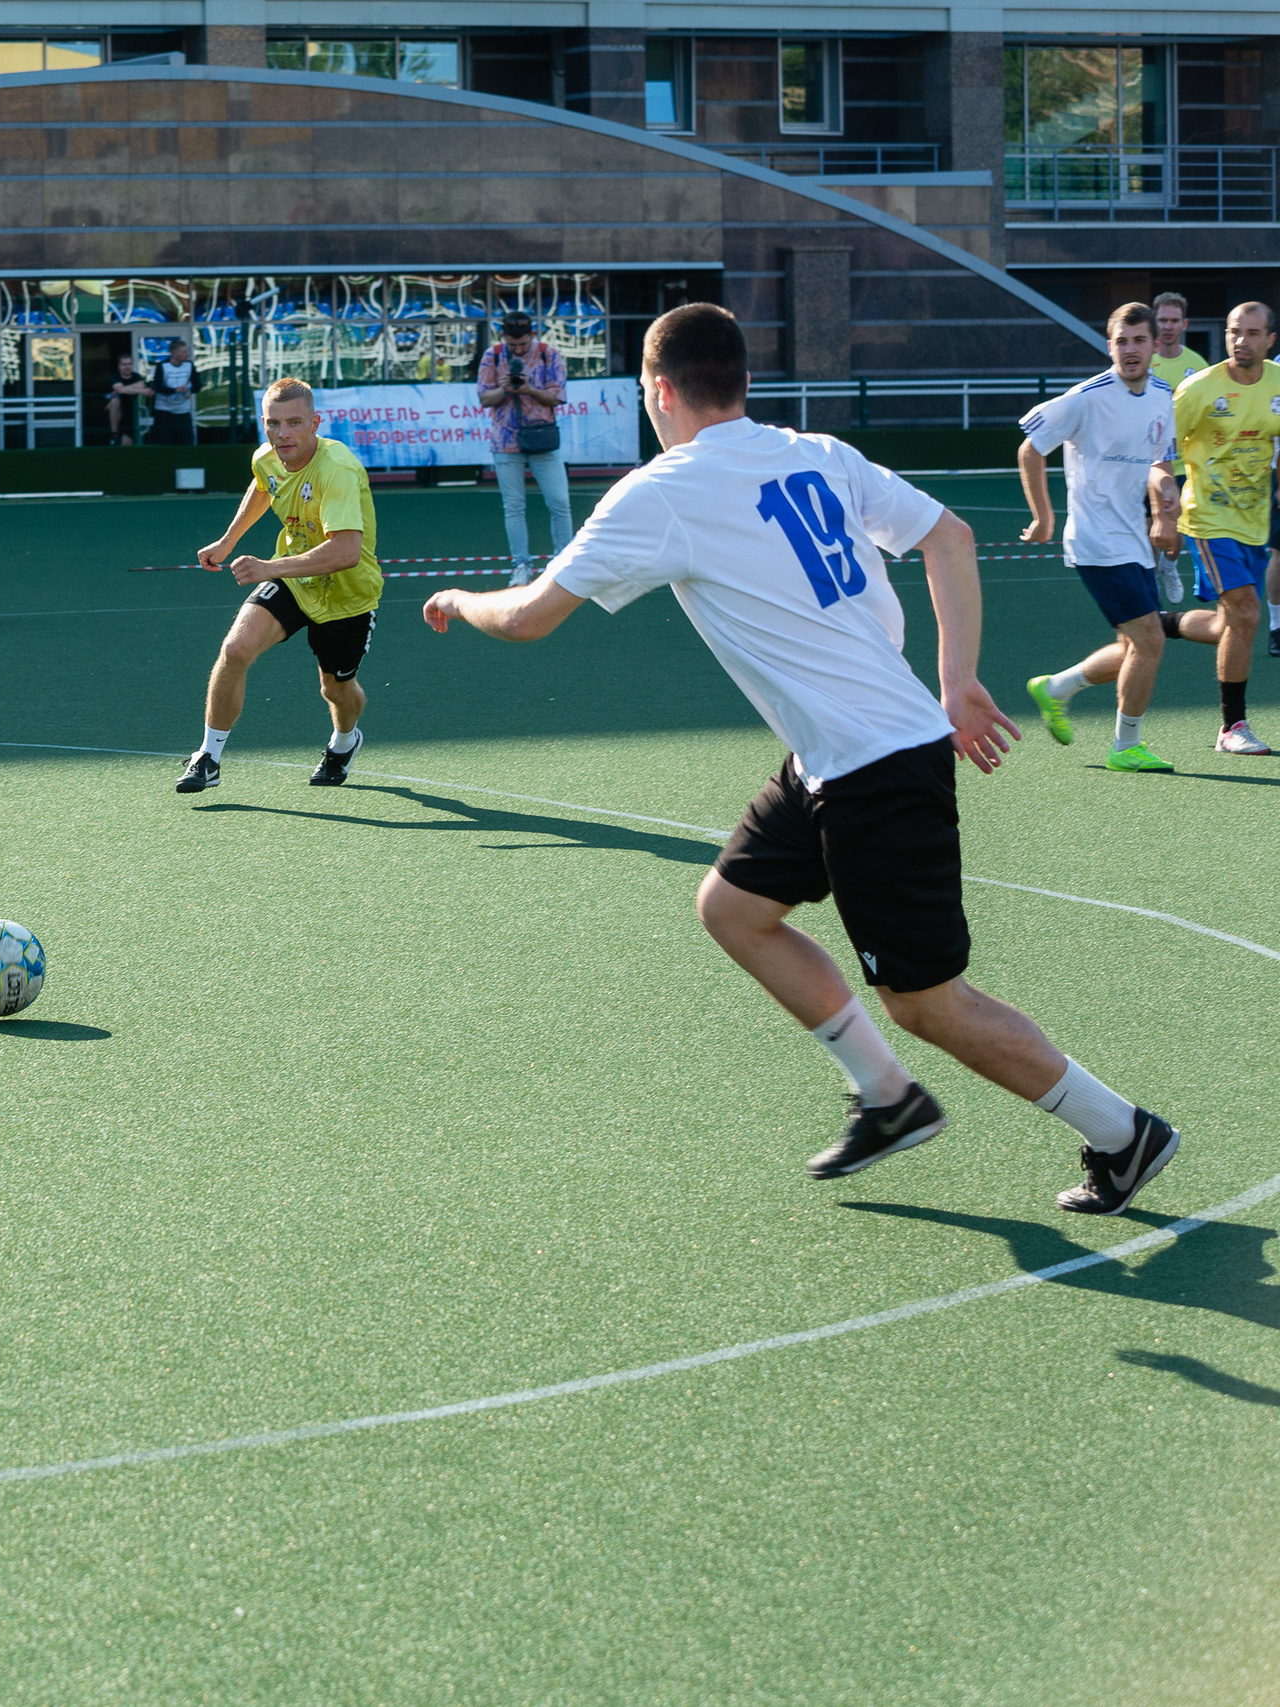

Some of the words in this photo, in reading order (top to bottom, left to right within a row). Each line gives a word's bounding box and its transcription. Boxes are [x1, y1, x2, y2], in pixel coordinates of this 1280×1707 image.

[314, 407, 421, 424] СТРОИТЕЛЬ
[355, 428, 465, 446] ПРОФЕССИЯ
[755, 470, 867, 610] 19
